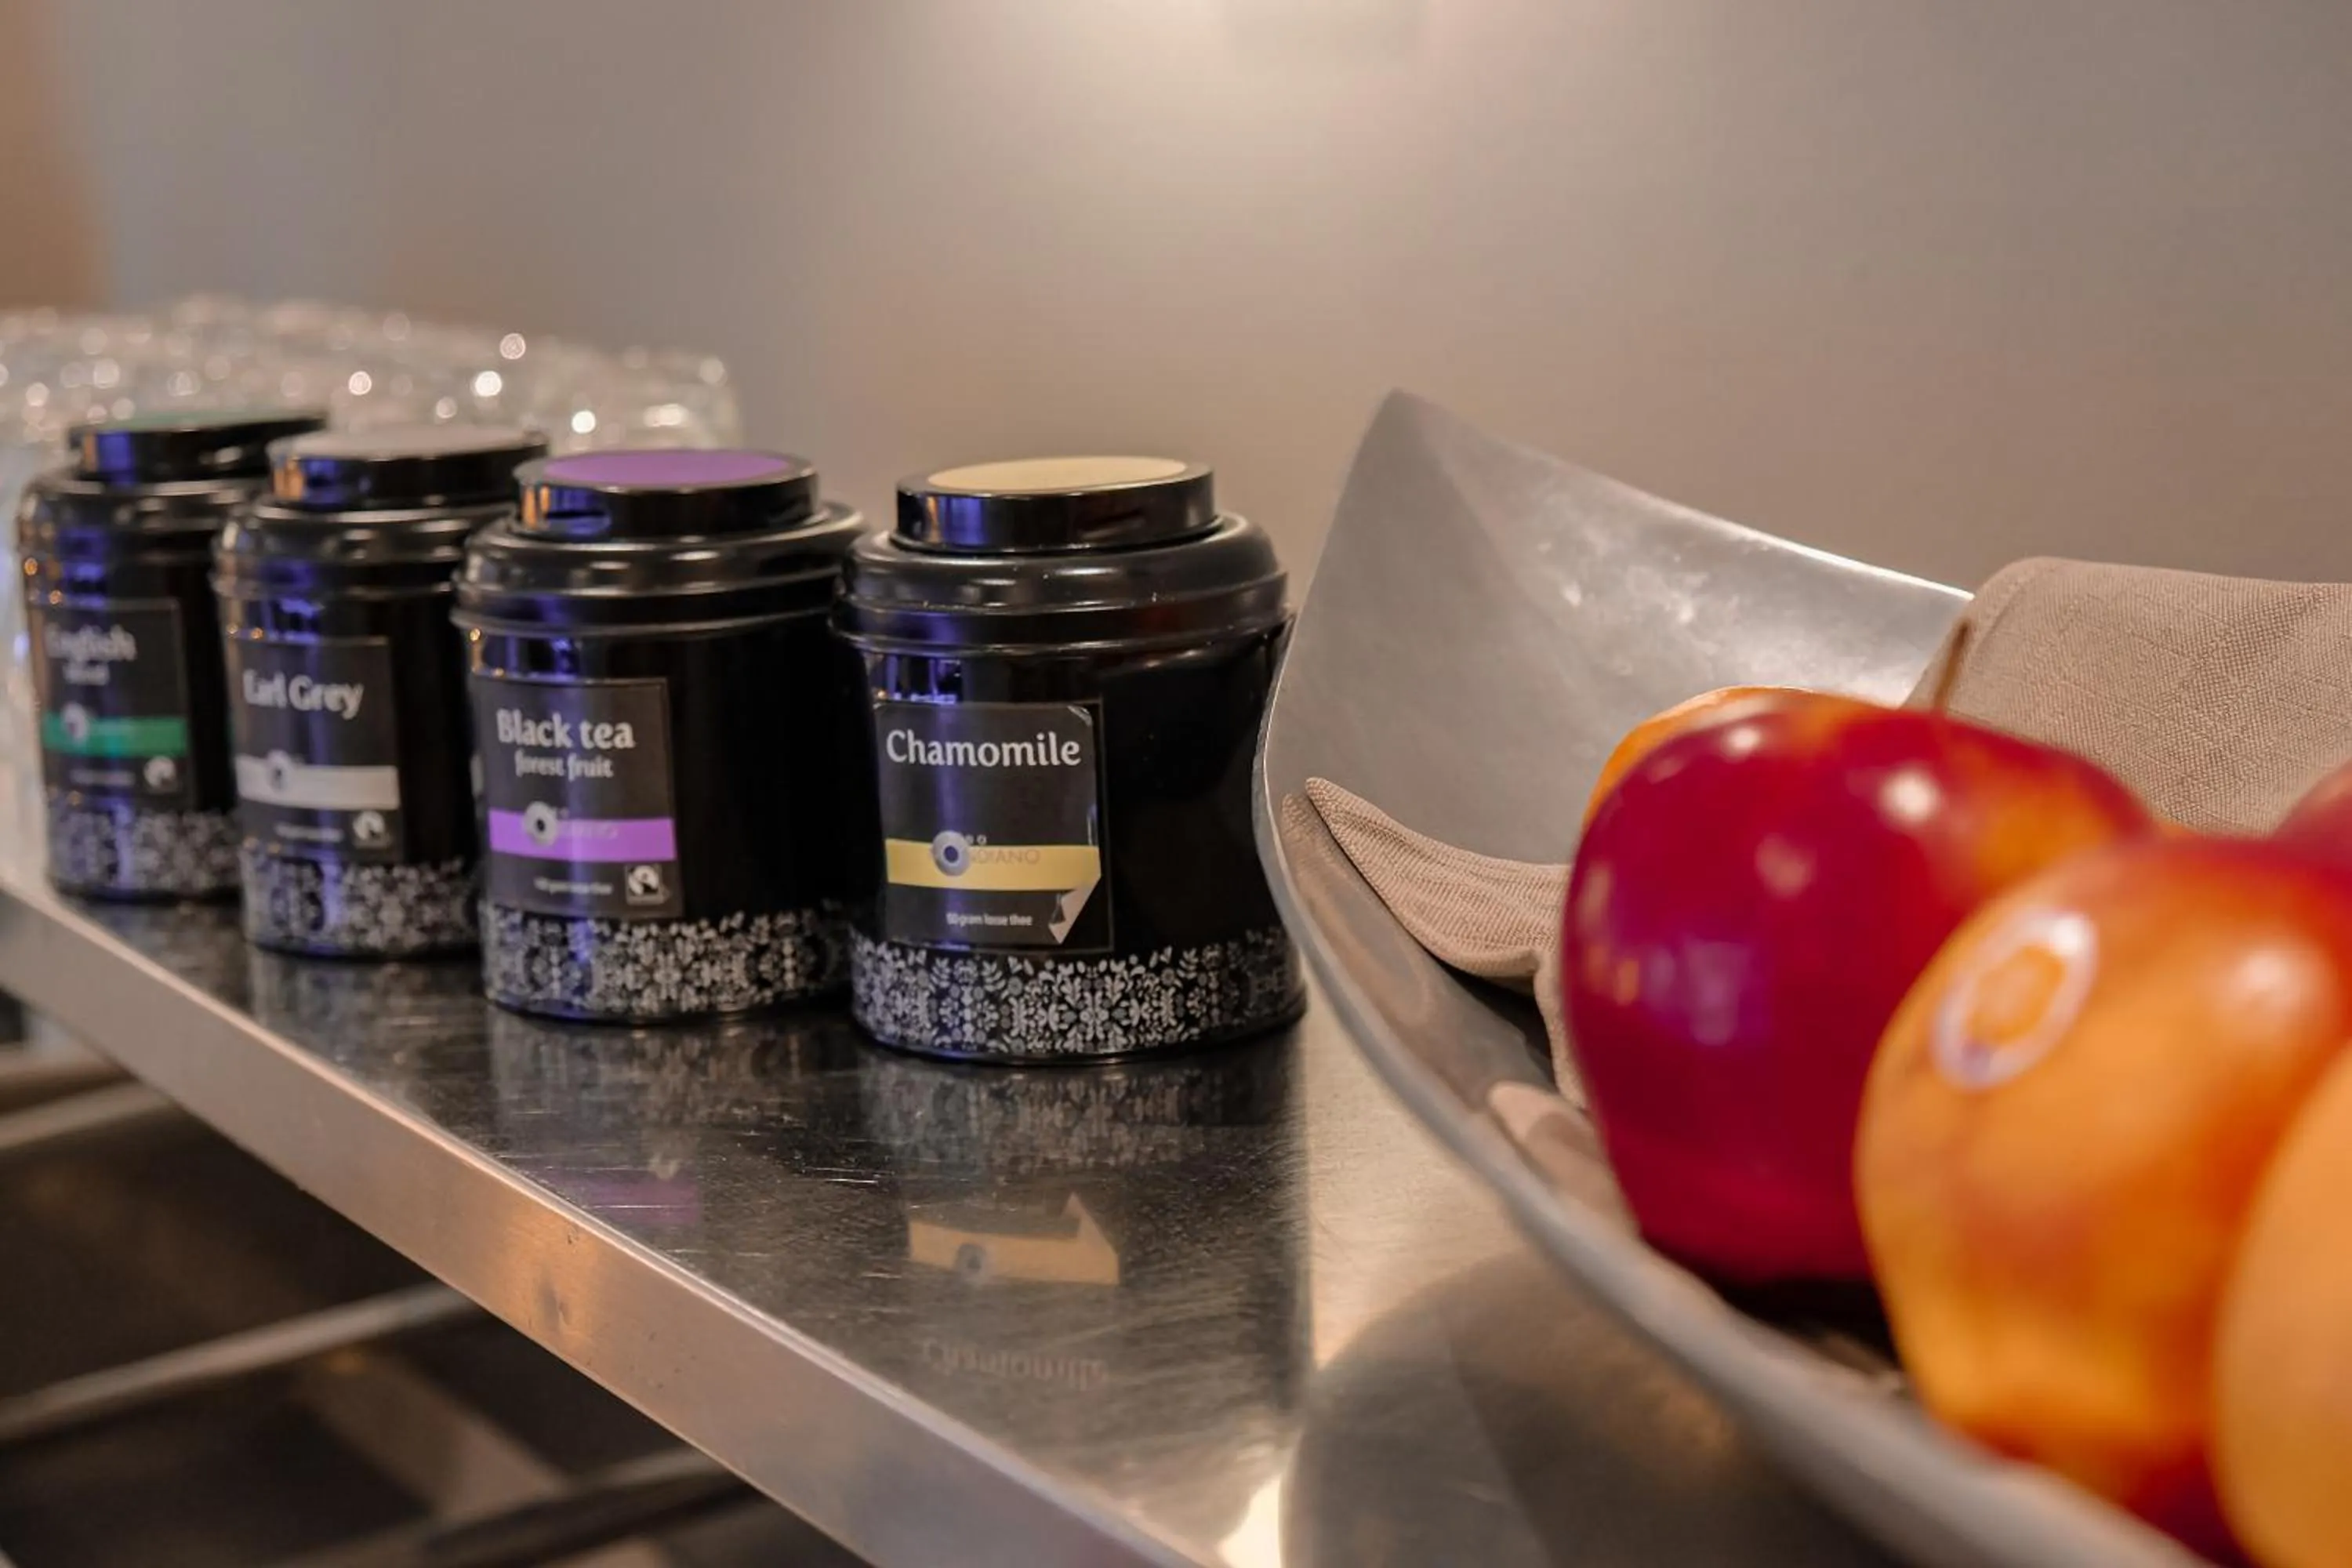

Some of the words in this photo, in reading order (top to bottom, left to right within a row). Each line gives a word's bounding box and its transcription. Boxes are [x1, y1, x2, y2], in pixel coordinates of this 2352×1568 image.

[289, 674, 365, 720] Grey
[496, 708, 573, 748] Black
[579, 718, 636, 750] tea
[886, 729, 1082, 768] Chamomile
[514, 748, 566, 778] forest
[567, 752, 615, 782] fruit
